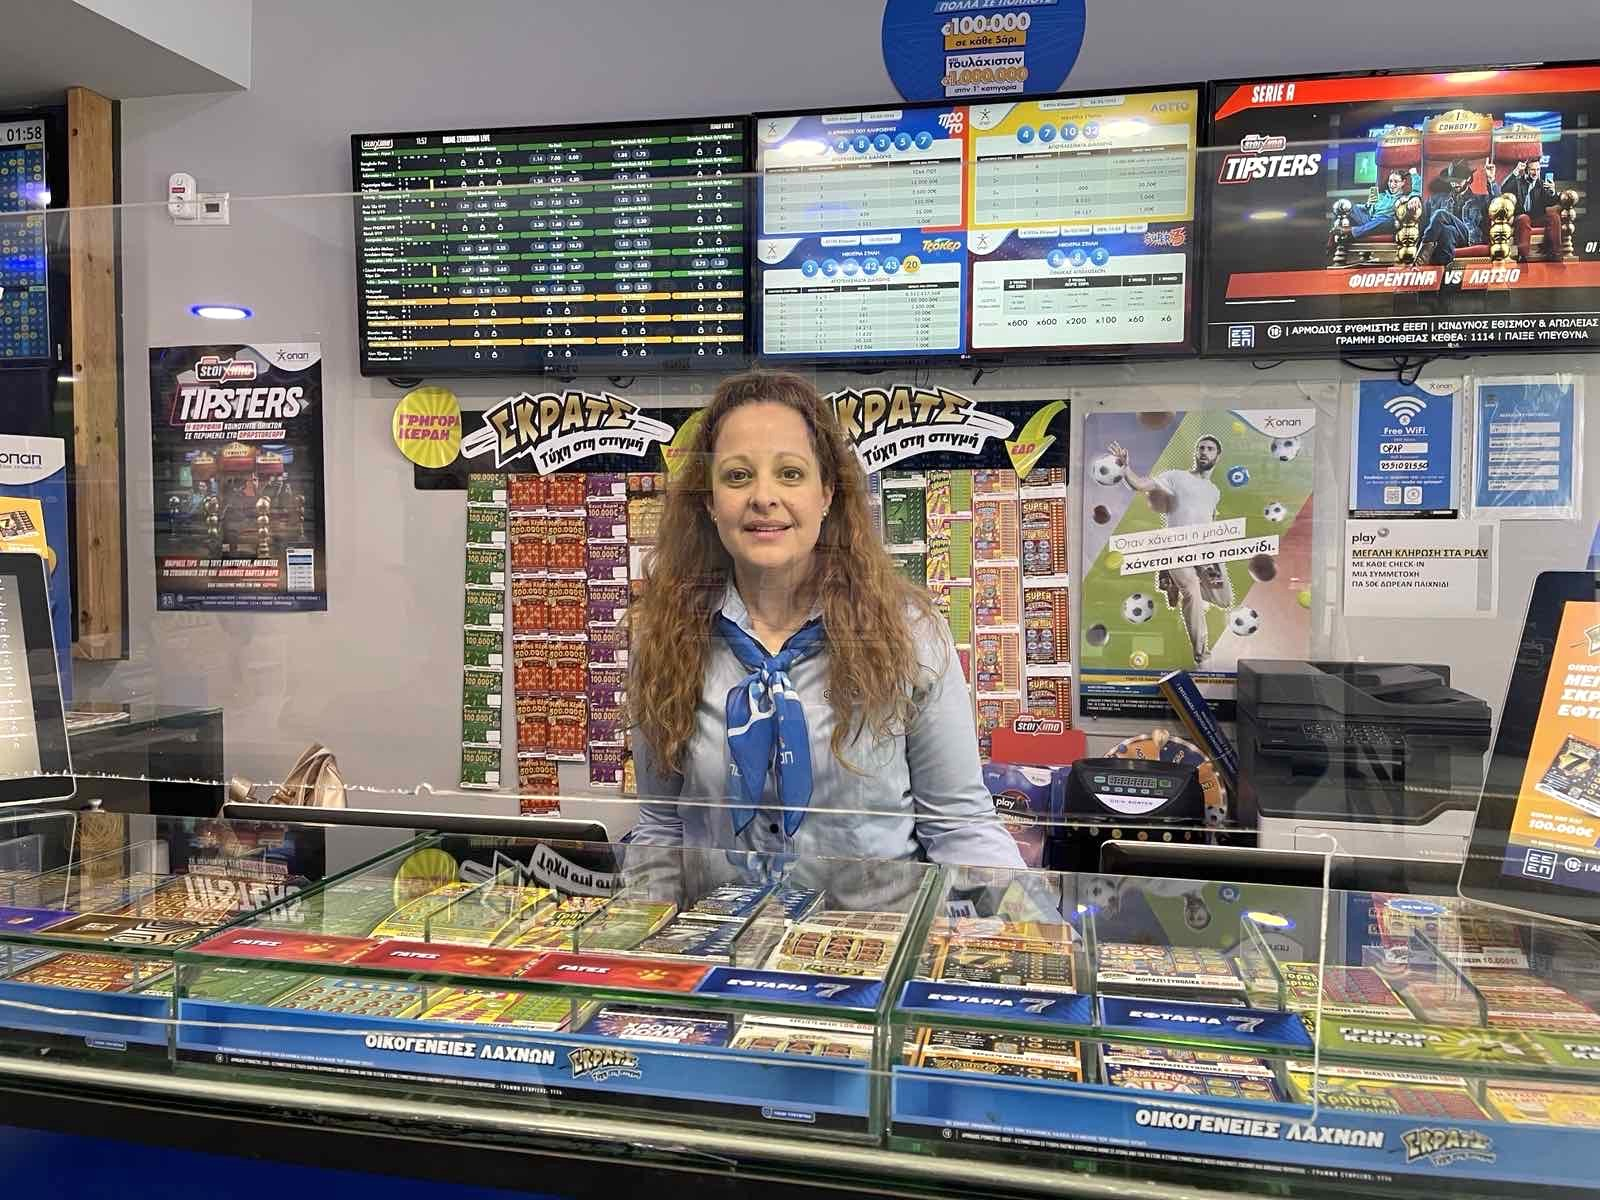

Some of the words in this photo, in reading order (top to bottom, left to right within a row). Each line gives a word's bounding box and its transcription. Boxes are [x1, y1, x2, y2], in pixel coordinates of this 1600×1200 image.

[940, 1, 979, 10] ΠΟΛΛΑ
[970, 36, 992, 45] κάθε
[949, 56, 1022, 69] τουλάχιστον
[1251, 85, 1284, 103] SERIE
[7, 127, 42, 141] 01:58
[1022, 131, 1029, 139] 4
[920, 137, 926, 145] 7
[1227, 153, 1321, 180] TIPSTERS
[885, 261, 897, 269] 43
[906, 261, 918, 269] 20
[1349, 270, 1437, 288] ΦΙΟΡΕΝΤΙΝΑ
[1444, 270, 1462, 285] VS
[1469, 269, 1521, 284] ΛΑΤΣΙΟ
[1007, 319, 1028, 328] x600
[1036, 318, 1057, 326] x600
[1065, 317, 1087, 326] x200
[1096, 316, 1117, 324] x100
[1128, 315, 1144, 323] x60
[1161, 314, 1172, 322] x6
[1292, 325, 1342, 335] ΑΡΜΟΔΙΟΣ
[1345, 324, 1399, 333] ΡΥΘΜΙΣΤΗΣ
[1403, 322, 1428, 332] ΕΕΕΠ
[1438, 321, 1488, 331] ΚΙΝΔΥΝΟΣ
[1492, 319, 1536, 329] ΕΘΙΣΜΟΥ
[1539, 319, 1546, 328] &
[1549, 318, 1599, 328] ΑΠΩΛΕΙΑΣ
[1336, 334, 1375, 344] ΓΡΑΜΜΗ
[1377, 333, 1428, 343] ΒΟΗΘΕΙΑΣ
[1431, 333, 1469, 342] ΚΕΘΕΑ:
[1471, 332, 1495, 341] 1114
[1505, 331, 1535, 340] ΠΑΙΞΕ
[1537, 330, 1588, 340] ΥΠΕΥΘΥΝΑ
[180, 387, 304, 420] TIPSTERS
[837, 387, 973, 443] ΚΡΑΤΣ
[491, 391, 641, 453] ΣΚΡΑΤΣ
[399, 427, 450, 441] ΚΕΡΔΗ
[1384, 426, 1403, 435] Free
[1405, 426, 1426, 434] WiFi
[539, 445, 571, 469] Τύχη
[573, 438, 596, 453] στη
[598, 434, 645, 452] στιγμή
[863, 440, 897, 466] Τύχη
[900, 433, 925, 448] στη
[928, 430, 980, 447] στιγμή
[1011, 443, 1035, 456] ΕΔΩ
[1023, 503, 1049, 512] SUPER
[1114, 534, 1144, 550] Όταν
[1147, 531, 1188, 547] χάνεται
[1352, 532, 1376, 545] play
[1125, 557, 1173, 571] χάνεται
[1177, 553, 1198, 564] και
[1200, 551, 1215, 562] το
[1219, 540, 1276, 559] παιχνίδι.
[1352, 549, 1393, 557] ΜΕΓΑΛΗ
[1395, 549, 1441, 557] ΚΛΗΡΩΣΗ
[1443, 549, 1461, 557] ΣΤΑ
[1464, 549, 1489, 557] PLAY
[1025, 591, 1052, 602] SUPER
[1028, 680, 1055, 690] SUPER
[996, 798, 1015, 809] play
[365, 1033, 477, 1057] ΟΙΚΟΓΕΝΕΙΕΣ
[480, 1047, 555, 1066] ΛΑΧΝΩΝ
[1136, 1109, 1280, 1138] ΟΙΚΟΓΕΝΕΙΕΣ
[1286, 1123, 1385, 1149] ΛΑΧΝΩΝ
